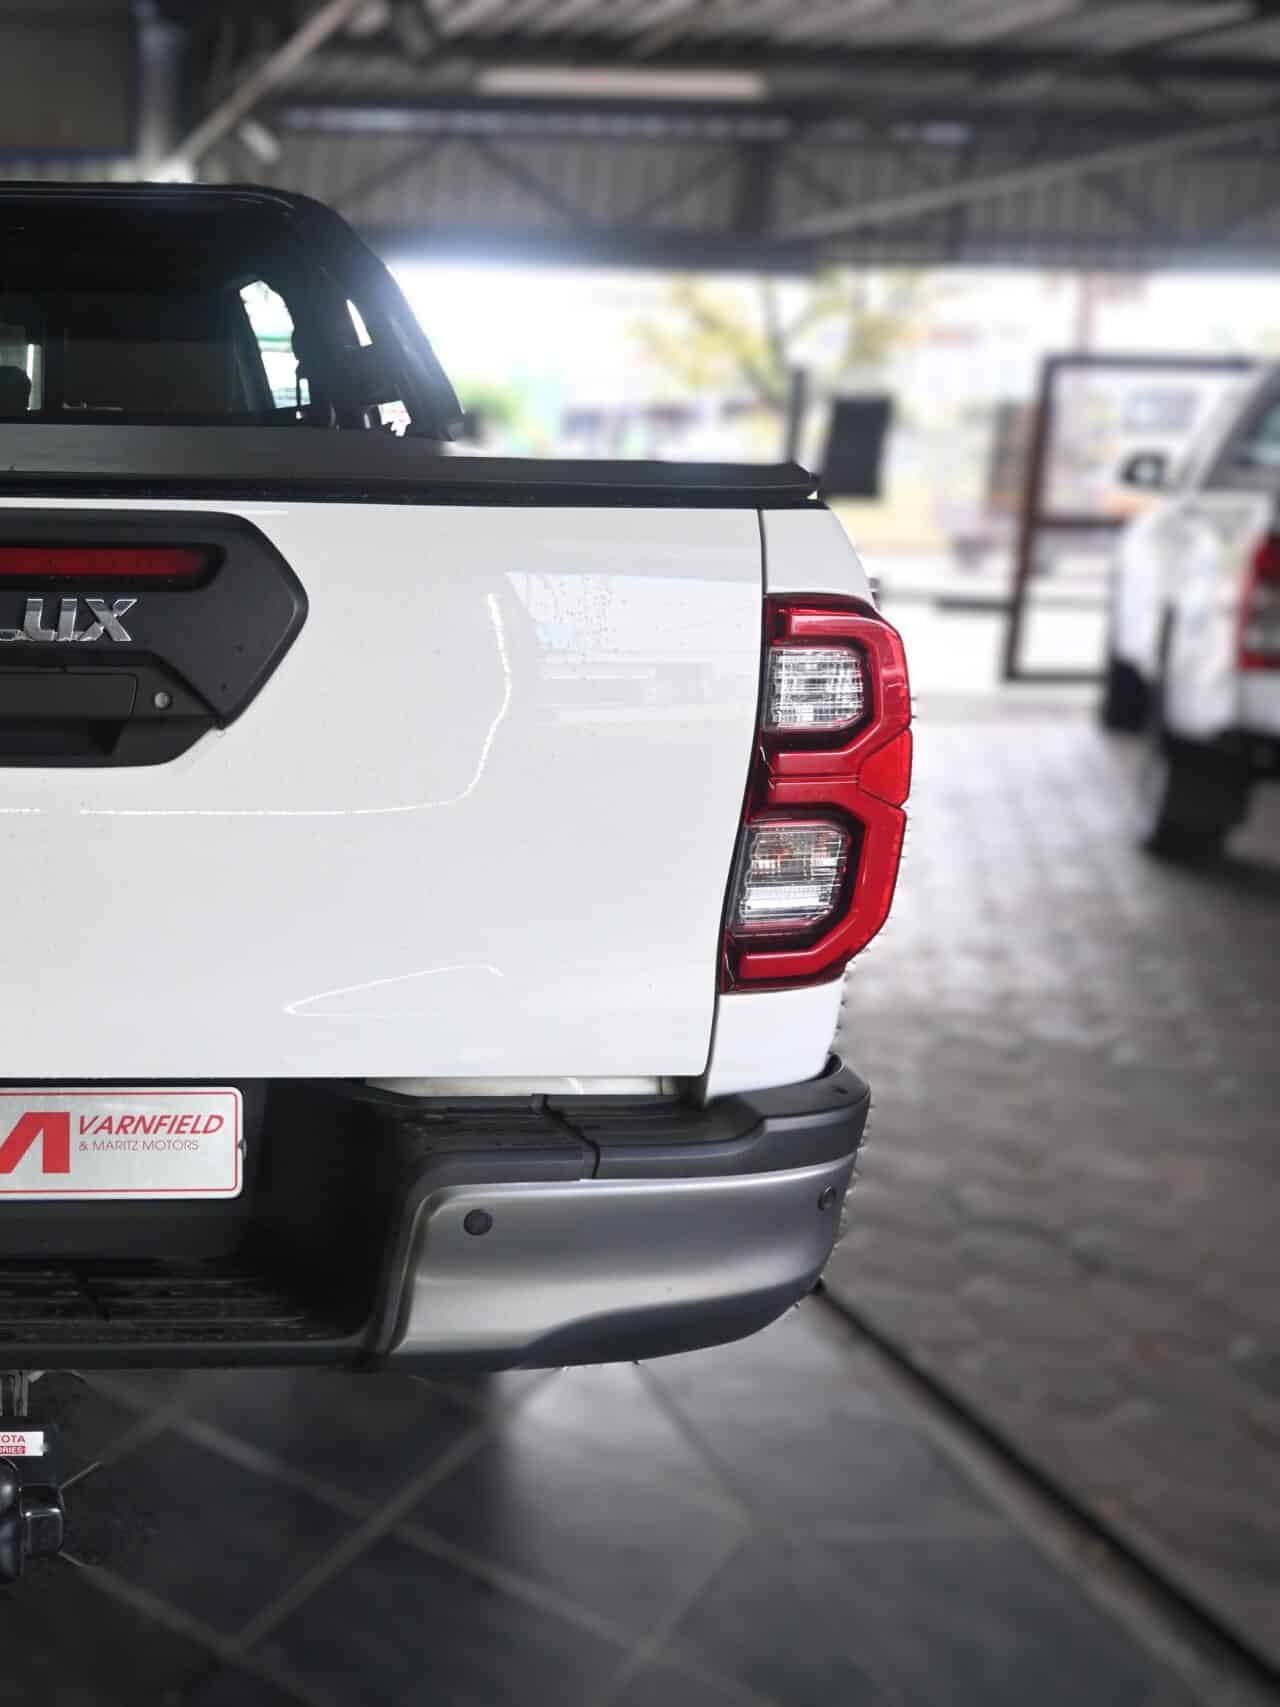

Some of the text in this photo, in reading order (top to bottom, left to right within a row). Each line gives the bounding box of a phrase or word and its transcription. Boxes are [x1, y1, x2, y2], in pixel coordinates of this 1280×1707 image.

[78, 1113, 225, 1136] VARNFIELD
[78, 1139, 200, 1151] & MARITZ MOTORS
